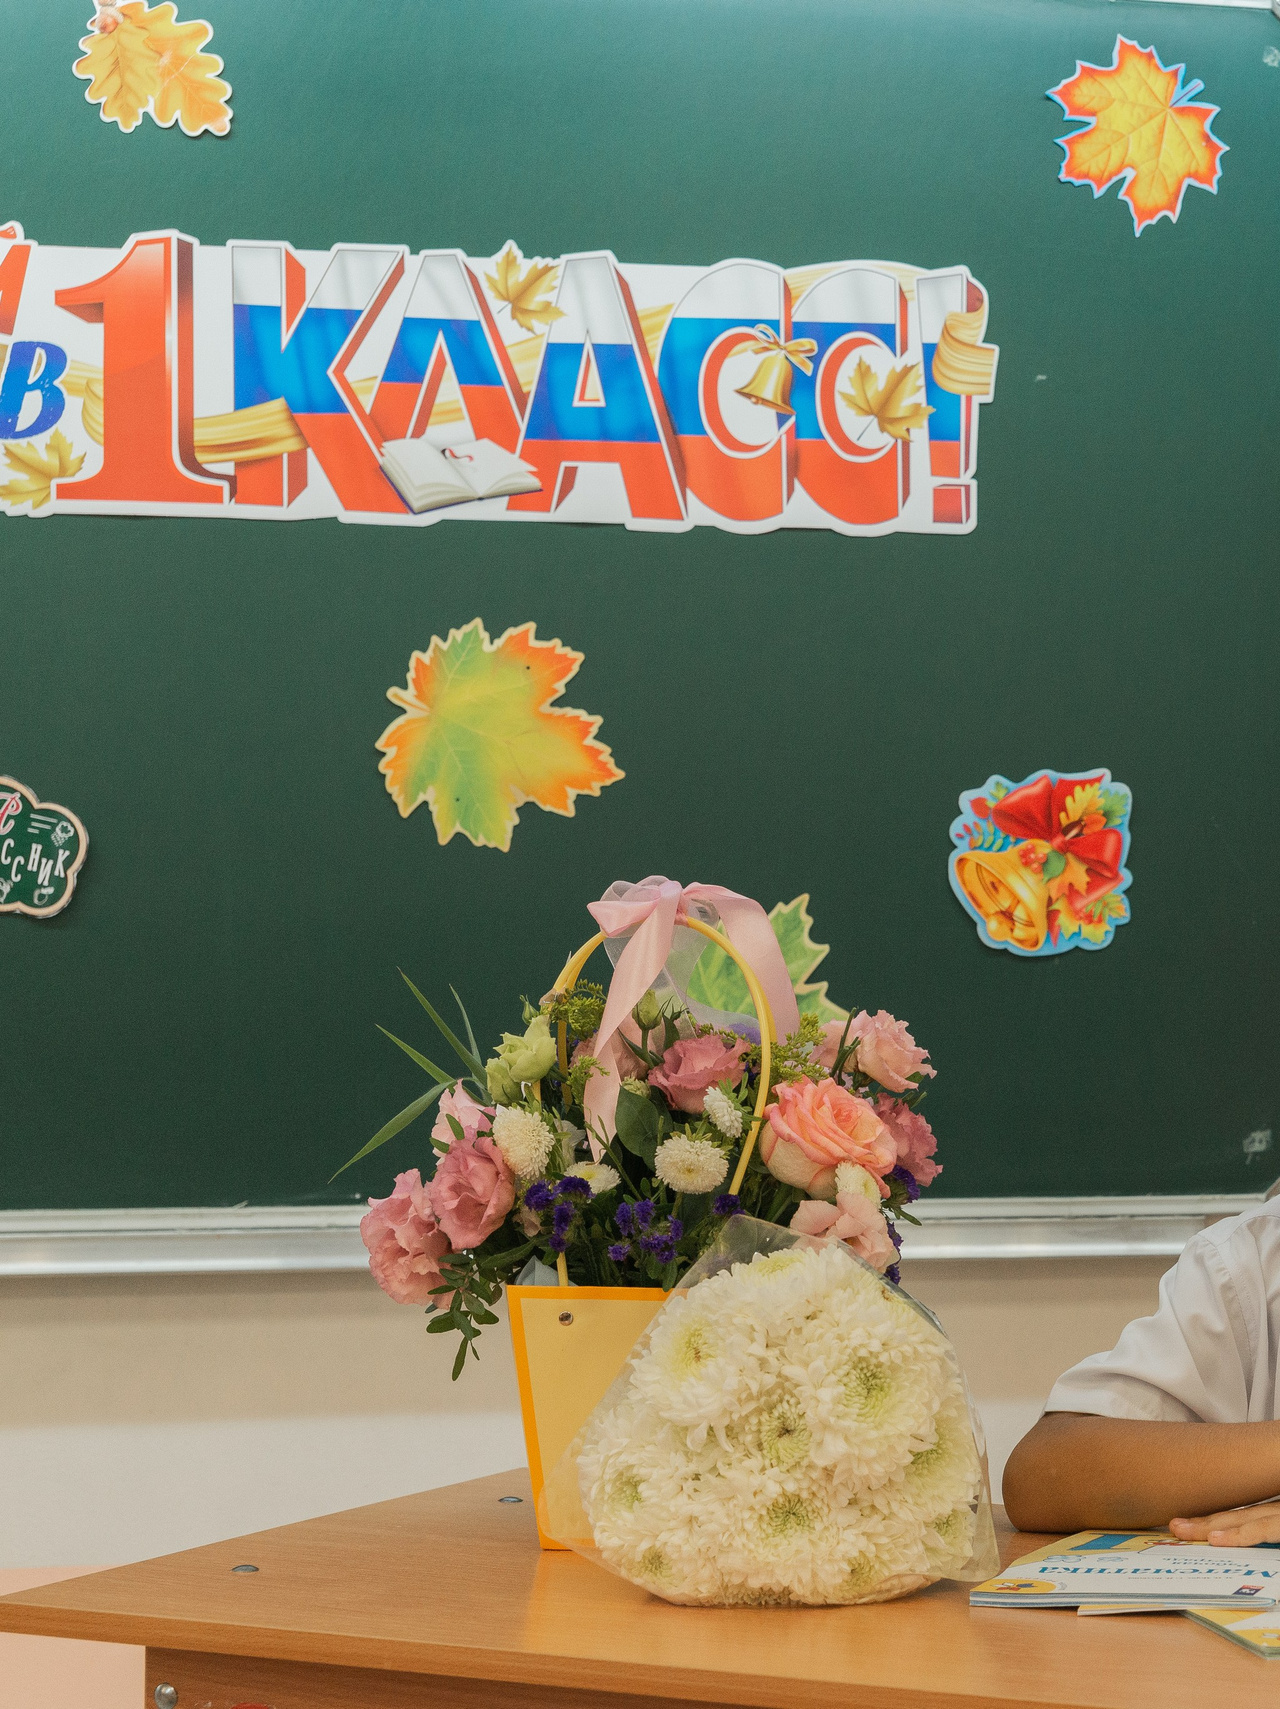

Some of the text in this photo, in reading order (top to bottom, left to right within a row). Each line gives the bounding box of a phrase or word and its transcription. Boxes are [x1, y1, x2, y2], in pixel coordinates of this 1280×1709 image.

[54, 236, 234, 503] 1
[232, 247, 974, 525] КЛАСС!
[1, 838, 70, 886] ССНИК
